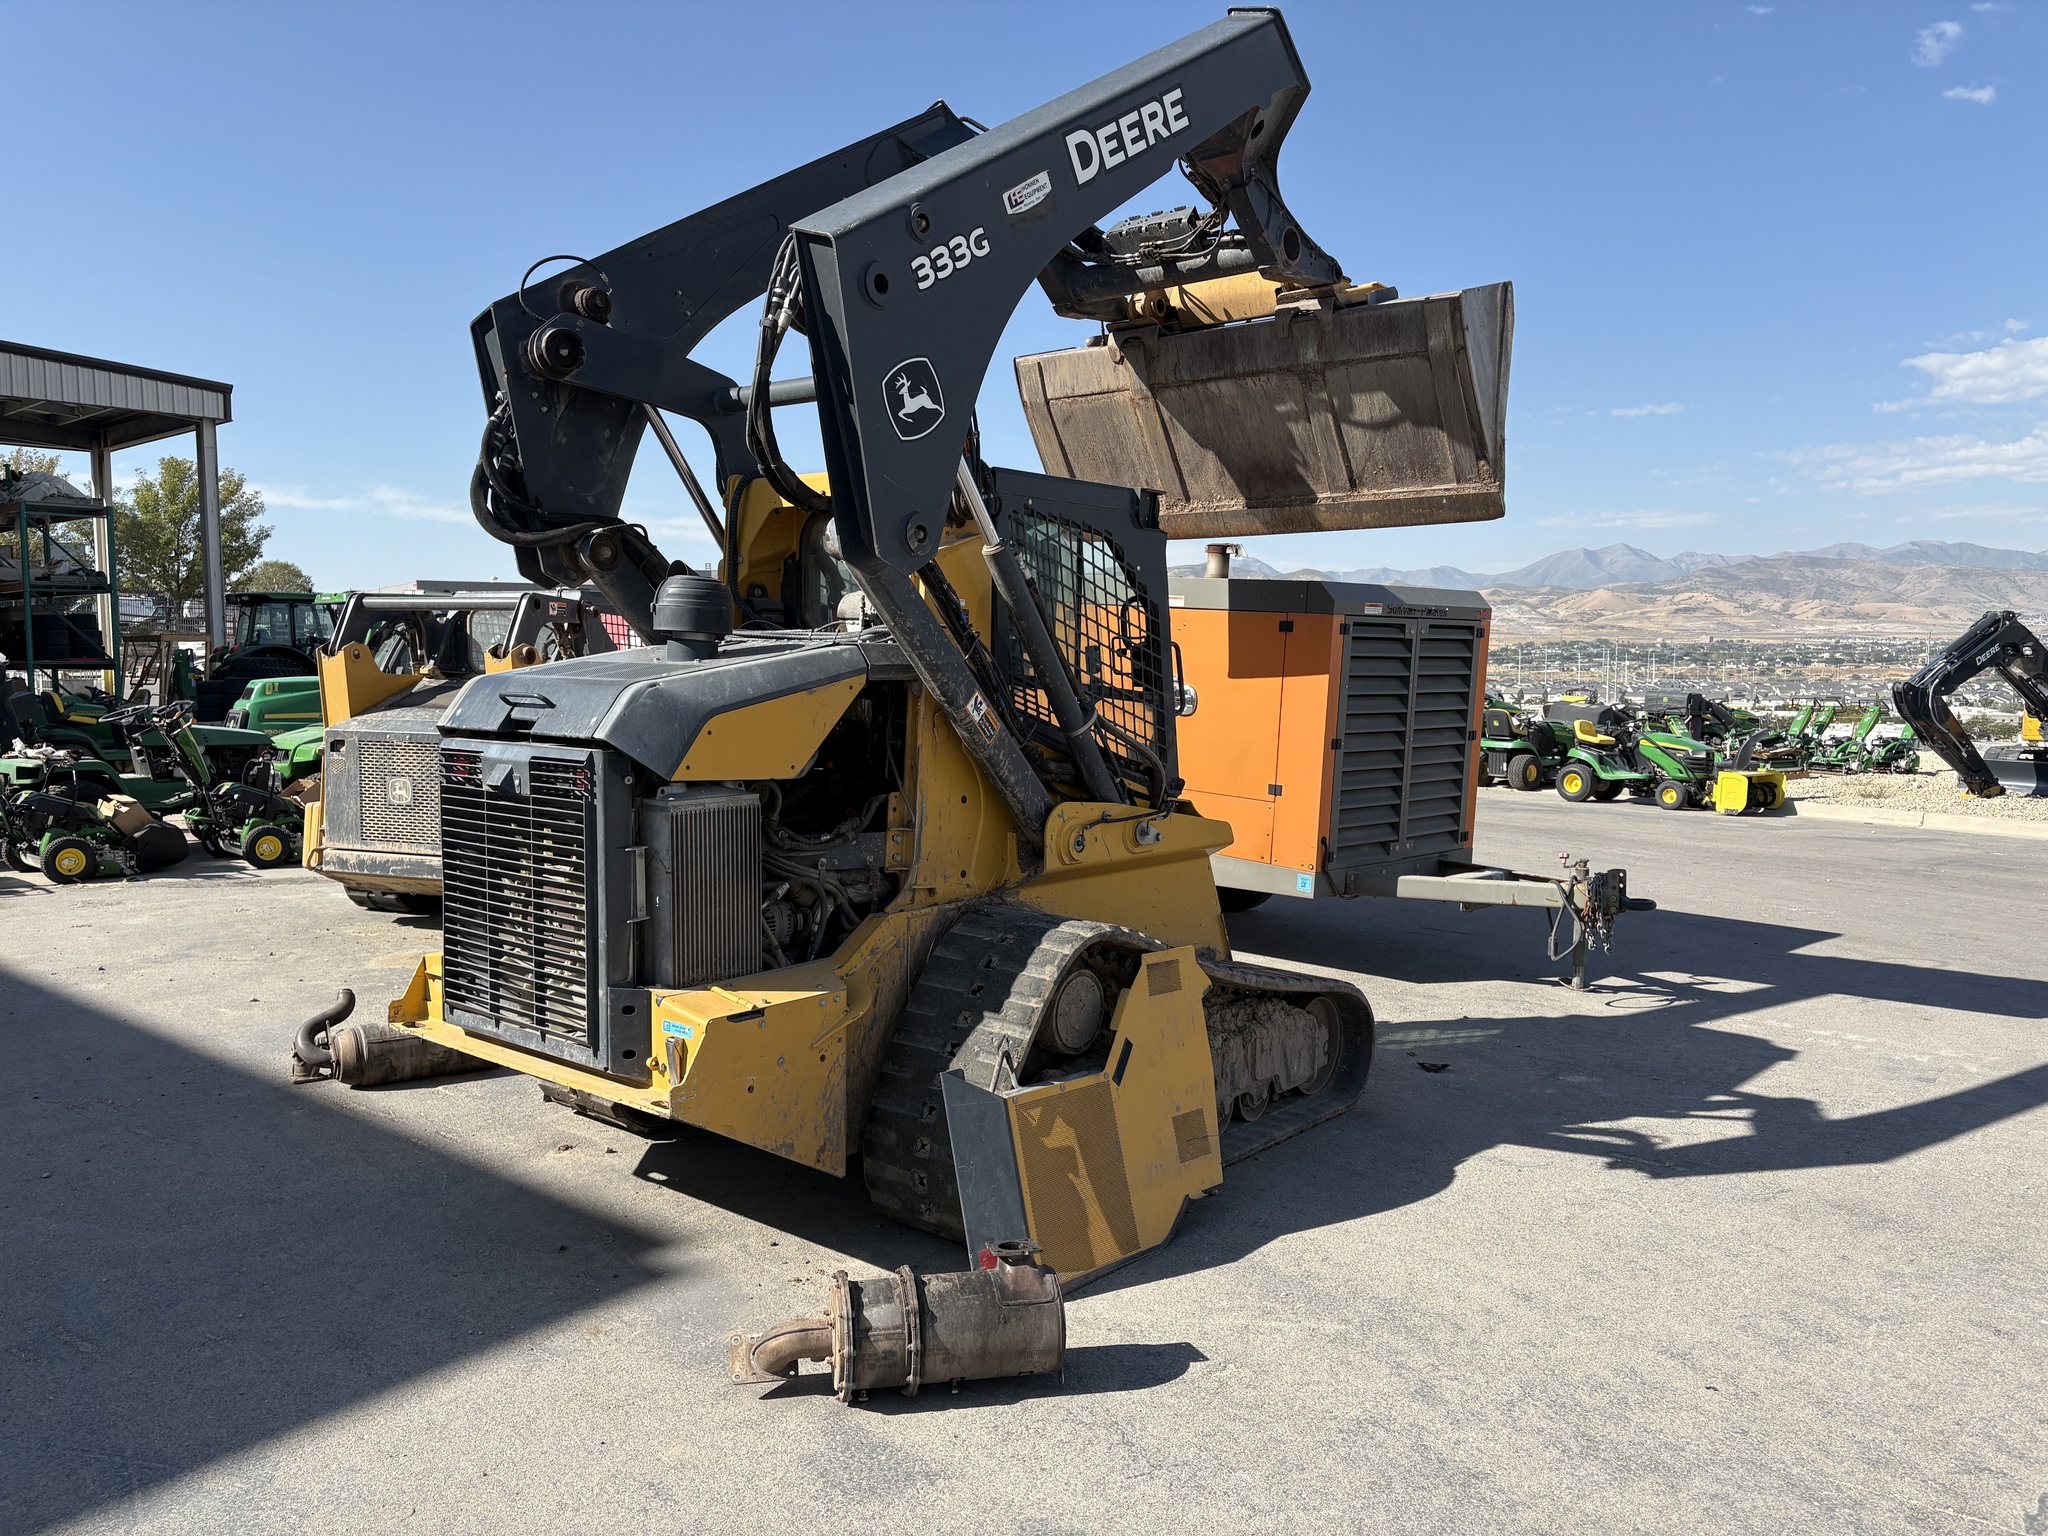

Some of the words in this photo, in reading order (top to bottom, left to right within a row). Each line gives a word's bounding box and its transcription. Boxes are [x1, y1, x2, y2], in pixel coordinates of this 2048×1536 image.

[1065, 88, 1190, 186] DEERE
[1021, 178, 1040, 192] HONNEN
[1023, 182, 1048, 200] EQUIPMENT
[911, 227, 991, 290] 333G
[1975, 642, 2001, 667] DEERE
